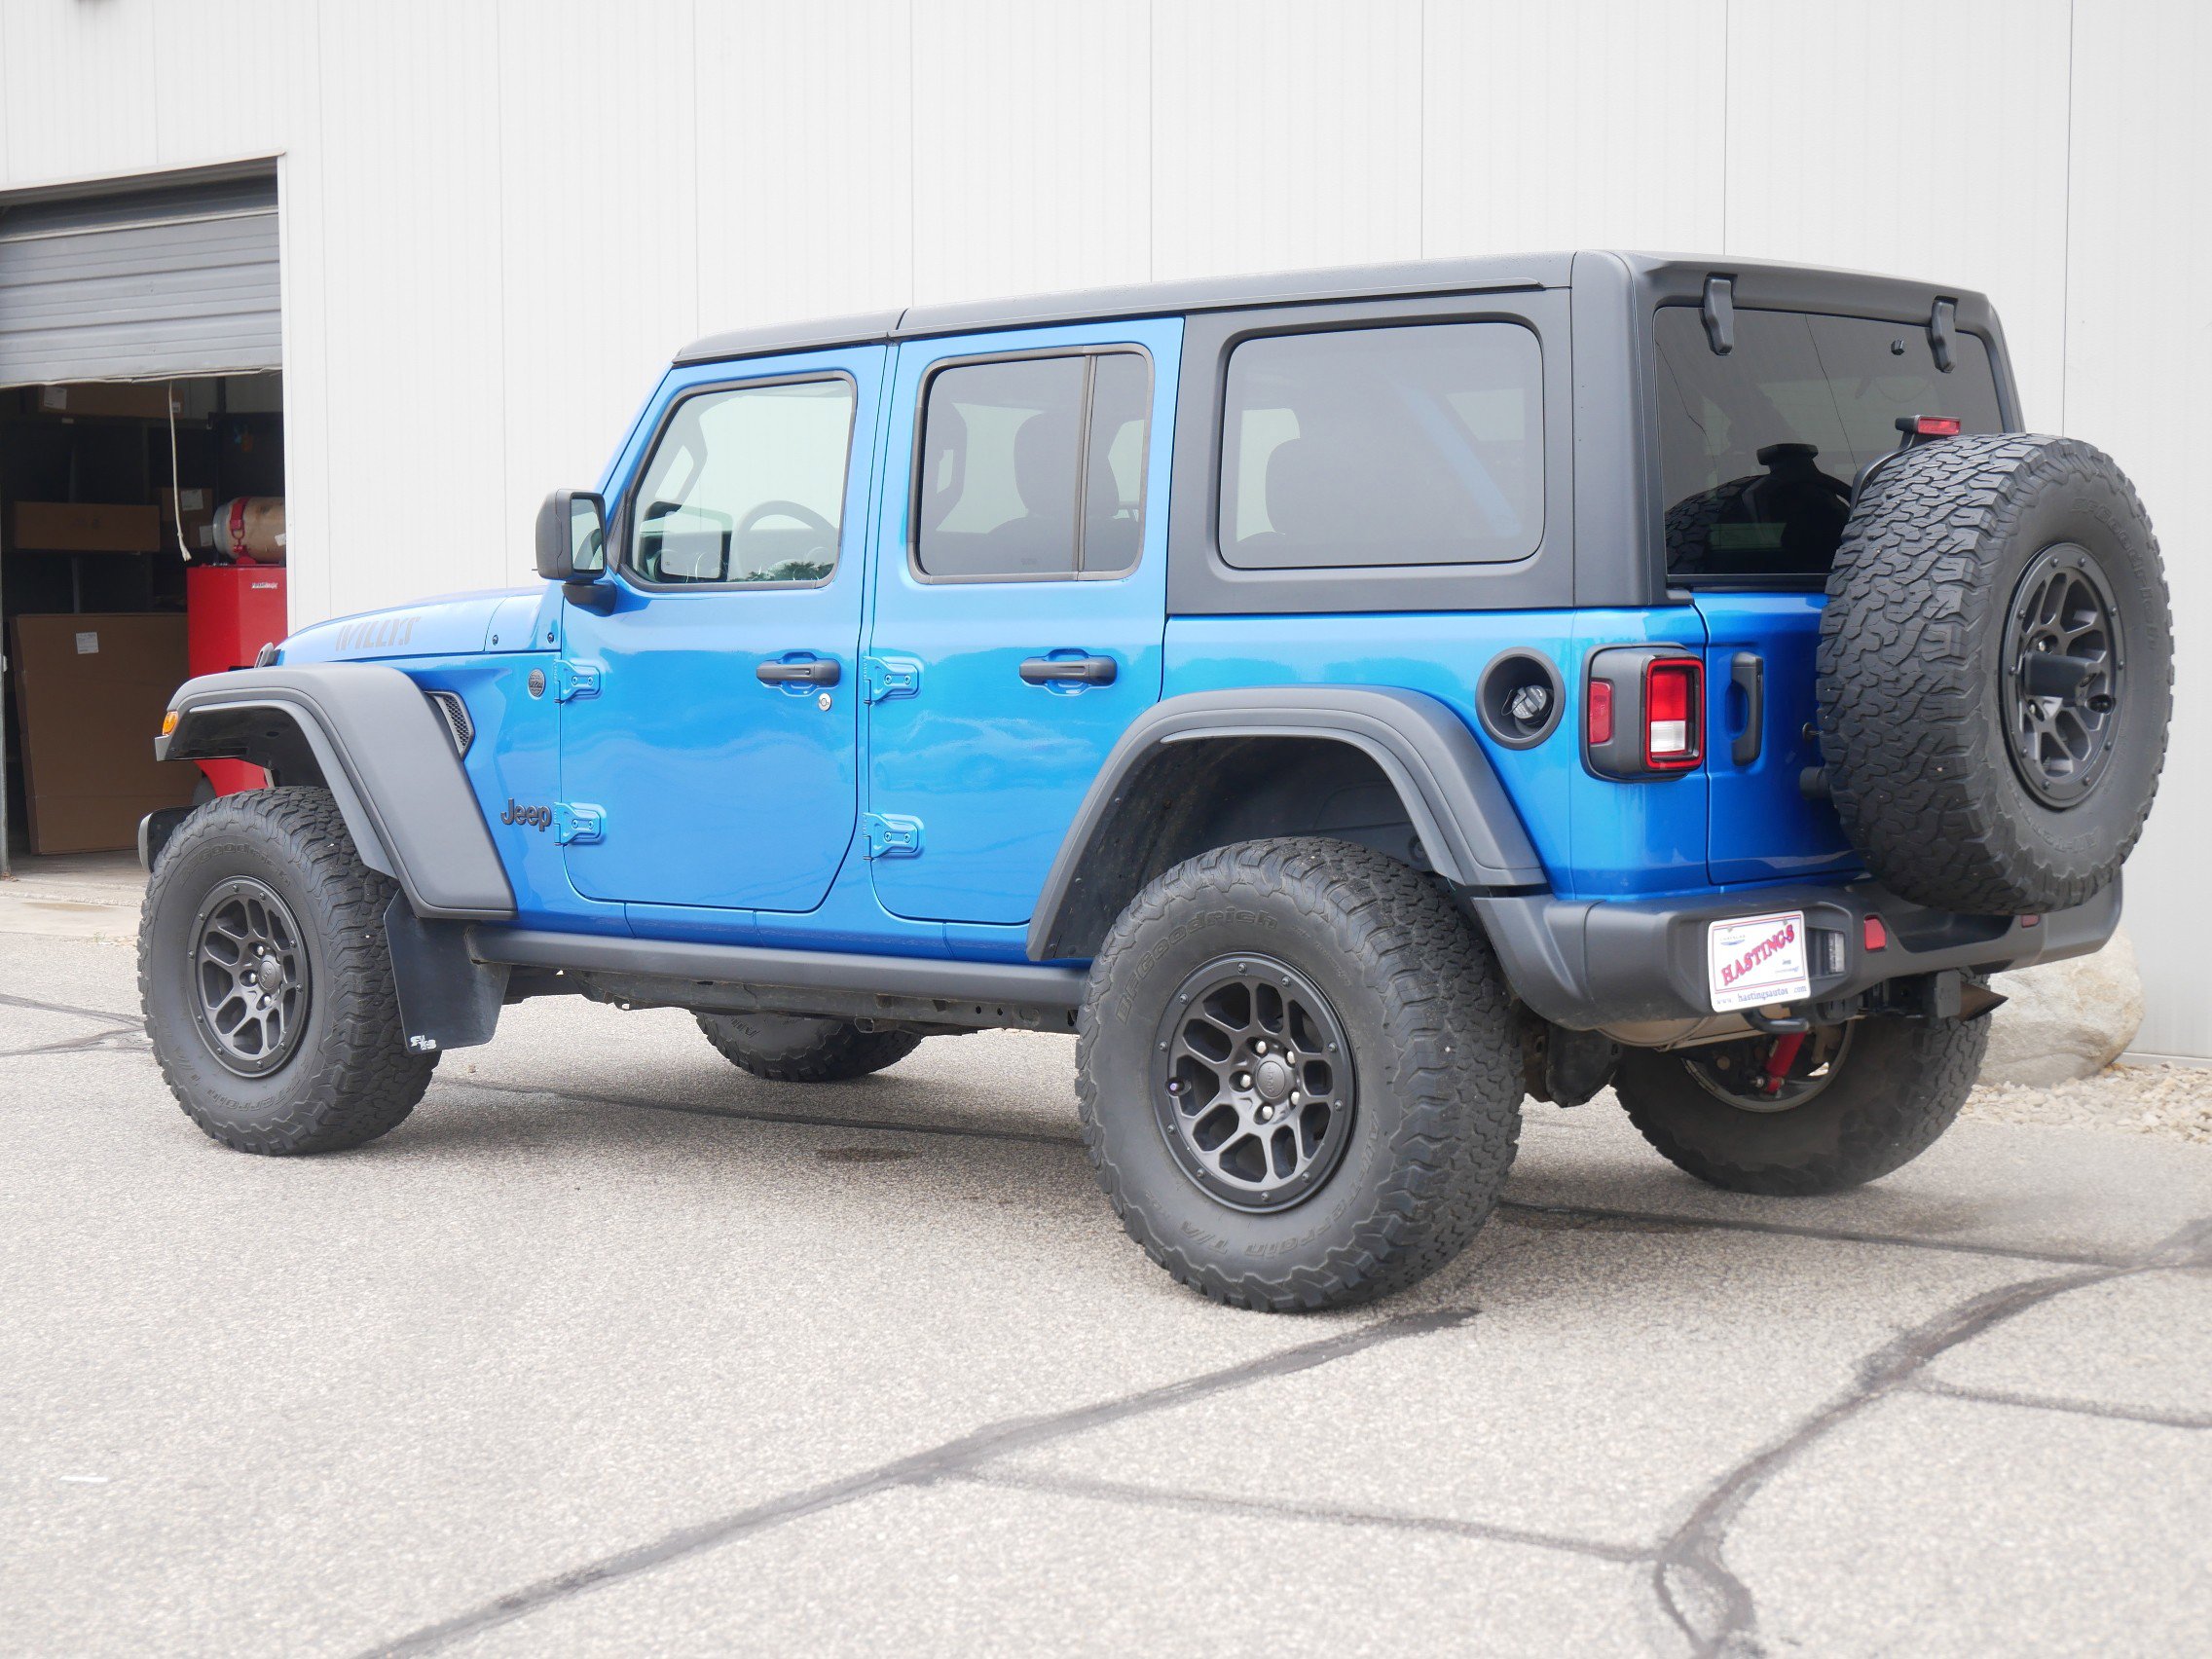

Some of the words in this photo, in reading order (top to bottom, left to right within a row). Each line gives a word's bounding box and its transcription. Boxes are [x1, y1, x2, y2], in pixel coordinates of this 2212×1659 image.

[335, 615, 421, 652] WILLYS
[499, 797, 552, 832] Jeep
[1115, 905, 1278, 1025] BFGoodrich
[1721, 924, 1794, 986] HASTINGS
